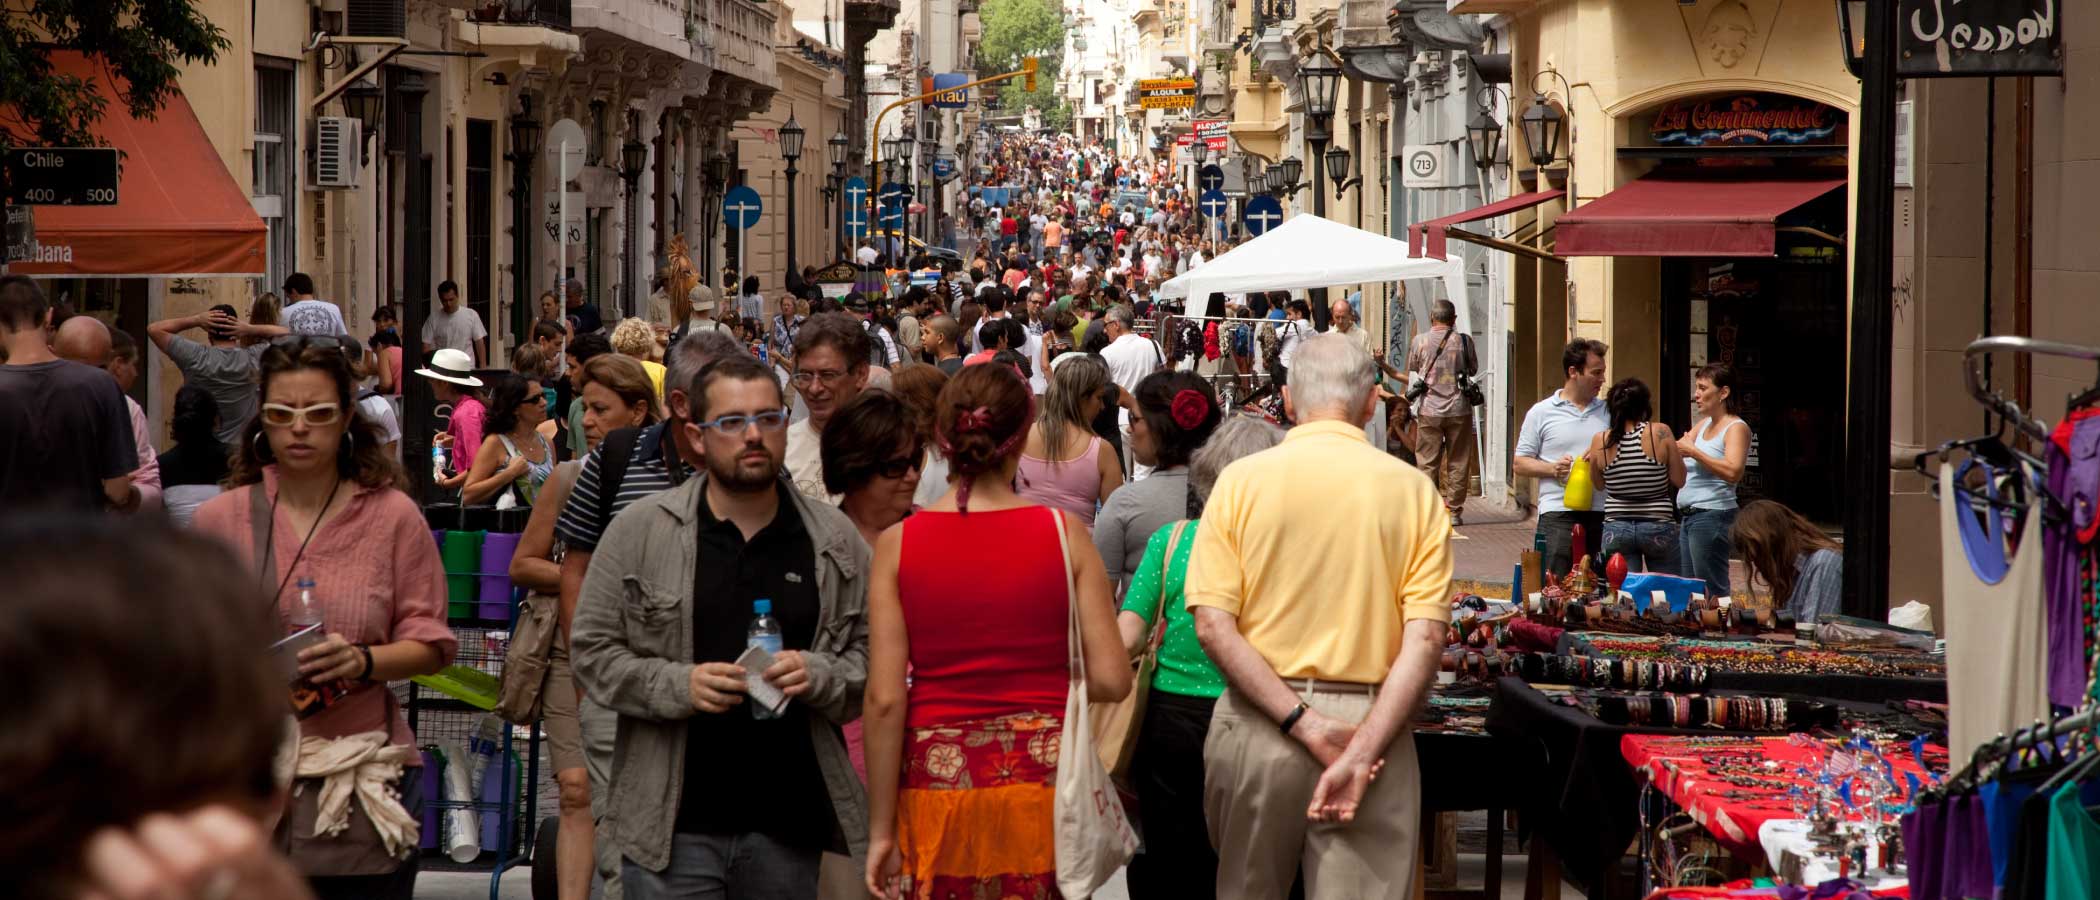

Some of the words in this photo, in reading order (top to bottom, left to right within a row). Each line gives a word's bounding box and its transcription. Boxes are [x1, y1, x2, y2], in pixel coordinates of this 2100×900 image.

[1692, 102, 1828, 130] Continental
[23, 151, 64, 168] Chile
[1415, 159, 1431, 170] 713
[25, 188, 54, 202] 400
[86, 188, 115, 202] 500
